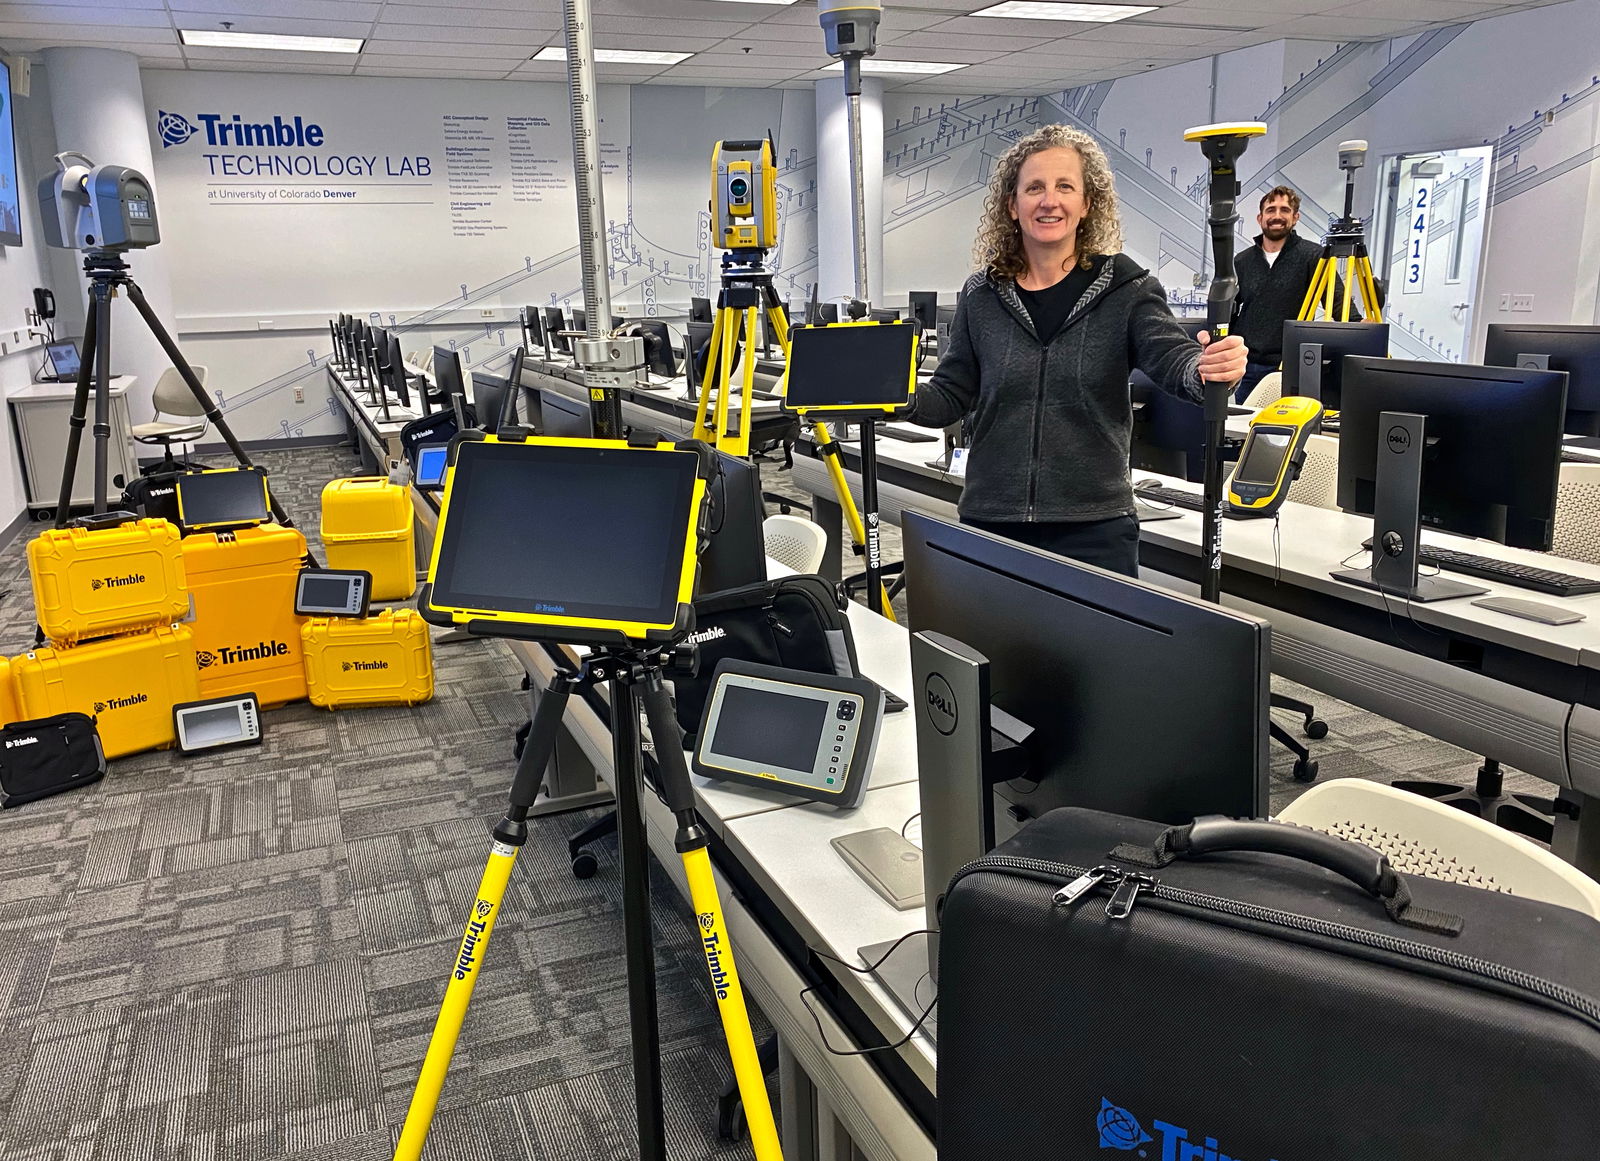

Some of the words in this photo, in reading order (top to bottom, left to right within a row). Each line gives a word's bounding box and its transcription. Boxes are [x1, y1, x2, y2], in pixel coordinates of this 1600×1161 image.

[197, 114, 324, 147] Trimble
[202, 154, 377, 177] TECHNOLOGY
[385, 156, 432, 177] LAB
[207, 190, 217, 199] at
[219, 189, 266, 200] University
[268, 190, 278, 199] of
[279, 189, 321, 199] Colorado
[323, 190, 357, 199] Denver
[1390, 435, 1408, 444] DELL
[155, 487, 175, 496] Trimble
[868, 526, 880, 569] Trimble
[104, 573, 146, 588] Trimble
[217, 640, 289, 665] Trimble
[353, 660, 389, 671] Trimble
[106, 693, 148, 710] Trimble
[928, 690, 955, 718] DELL
[12, 736, 38, 747] Trimble
[454, 920, 487, 980] Trimble
[704, 932, 730, 1000] Trimble
